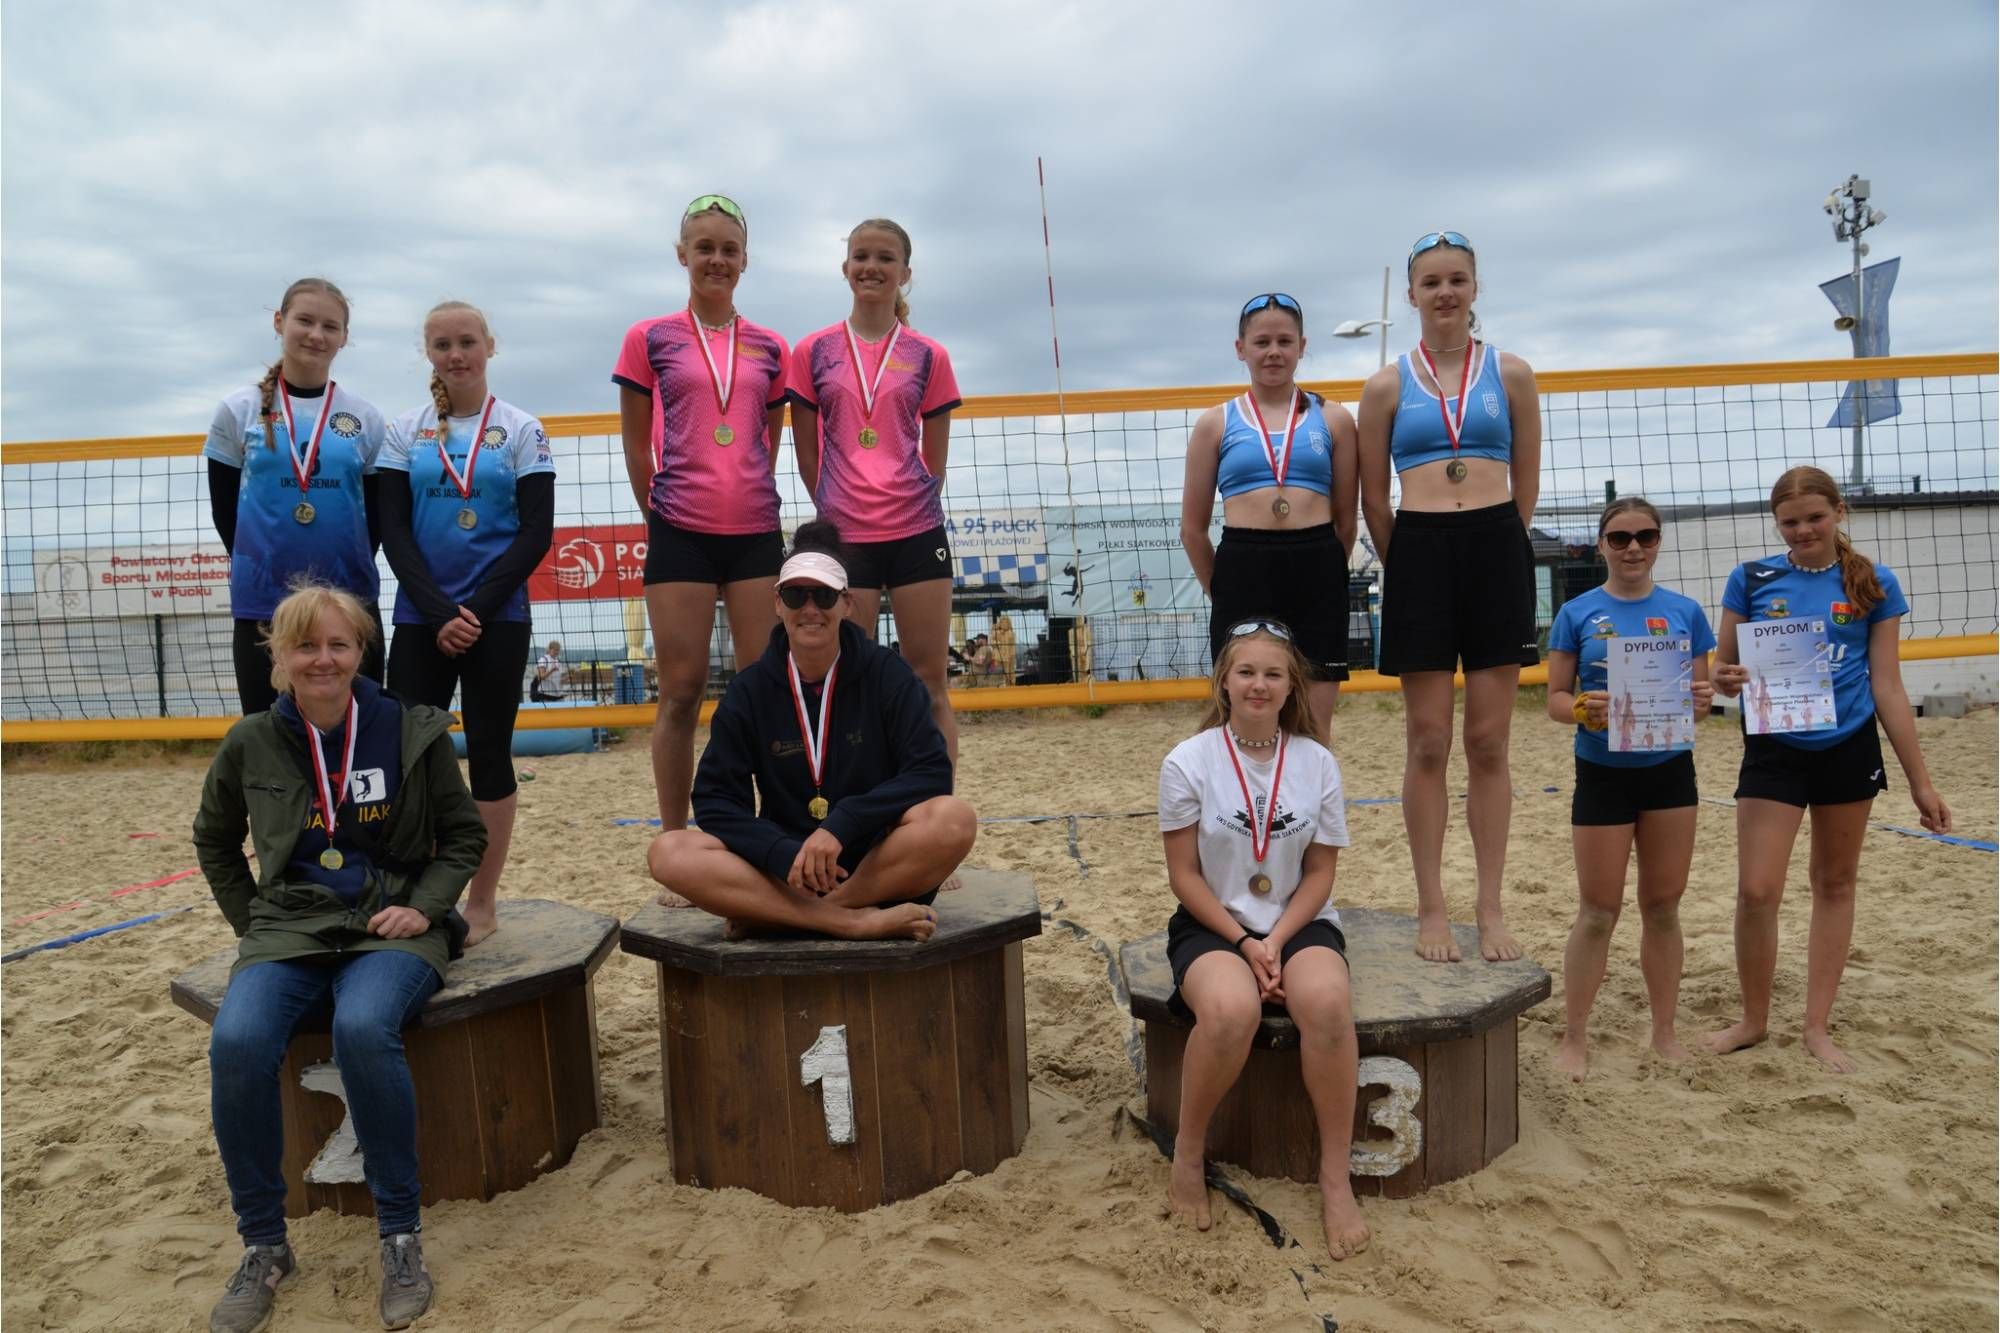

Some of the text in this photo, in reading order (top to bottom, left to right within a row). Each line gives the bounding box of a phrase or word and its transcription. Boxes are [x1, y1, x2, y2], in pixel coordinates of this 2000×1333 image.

[281, 477, 298, 488] UKS
[426, 487, 482, 498] UKS JASIAK
[964, 517, 987, 534] 95
[992, 518, 1037, 533] PUCK
[1110, 518, 1174, 528] WOJEWÓDZKI
[1098, 539, 1181, 549] PIŁKI SIATKOWEJ
[111, 553, 229, 567] Powiatowy Ośro
[101, 572, 151, 584] Sportu
[152, 587, 212, 598] w Pucku
[1754, 623, 1809, 638] DYPLOM
[1624, 641, 1677, 653] DYPLOM
[800, 1024, 856, 1146] 1
[300, 1058, 367, 1184] 2
[1349, 1056, 1422, 1177] 3
